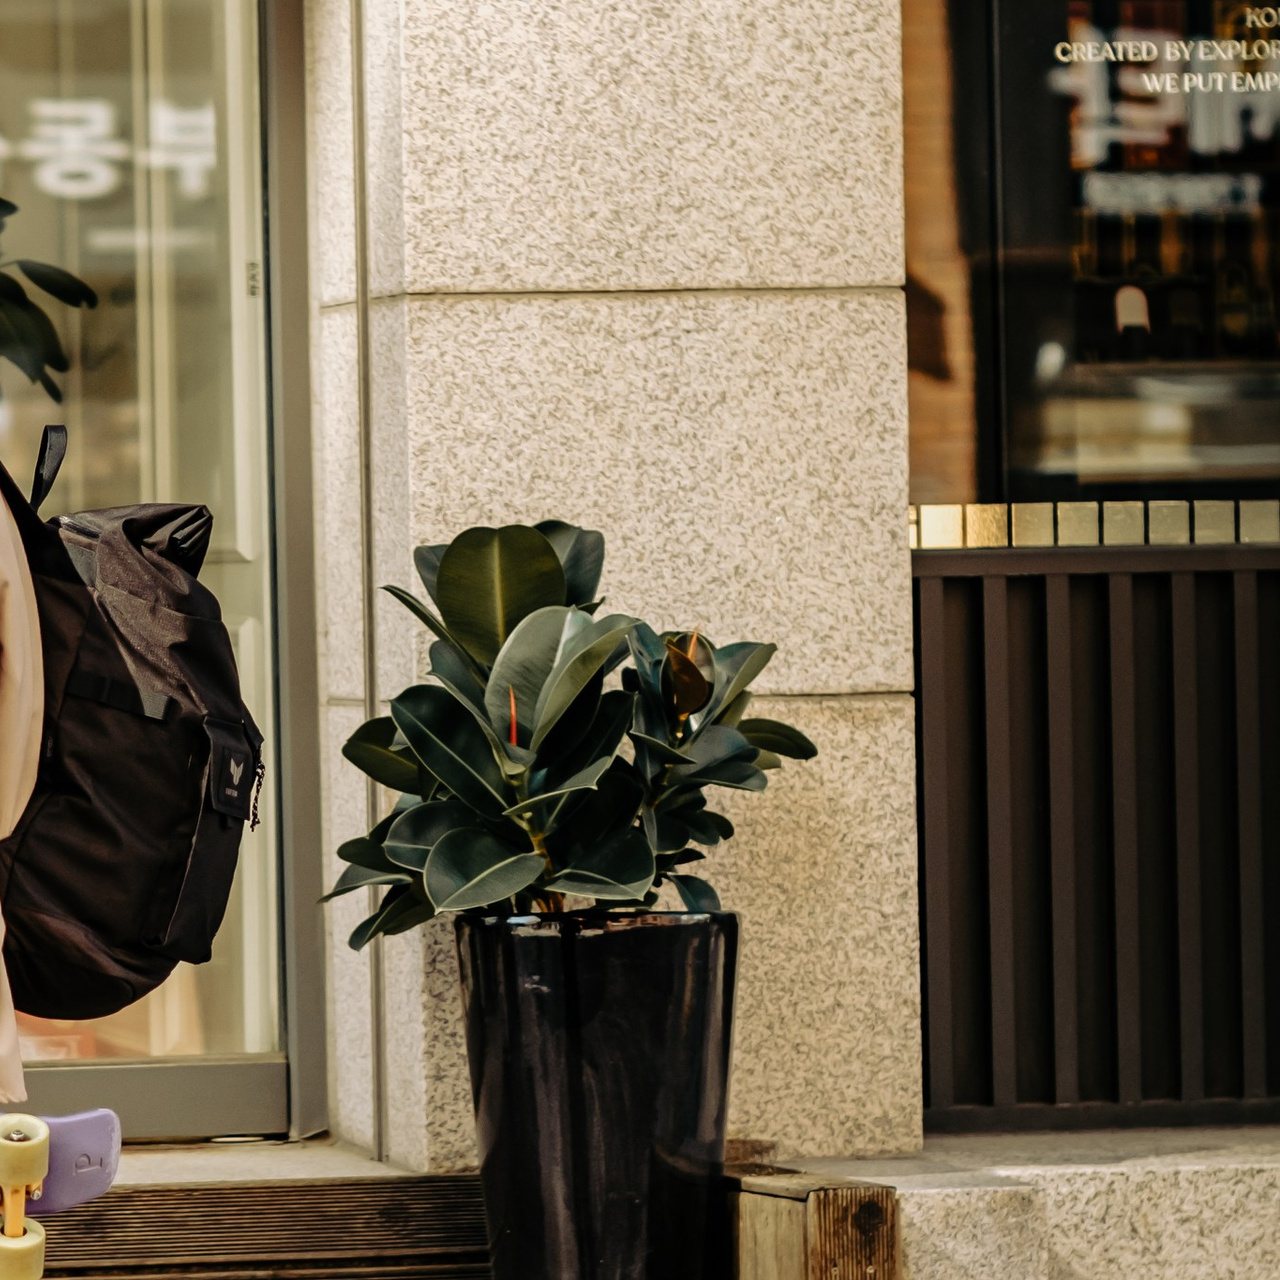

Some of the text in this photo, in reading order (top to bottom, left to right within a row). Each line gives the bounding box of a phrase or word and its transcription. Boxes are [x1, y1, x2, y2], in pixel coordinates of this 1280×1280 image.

[1245, 6, 1280, 28] KO
[1054, 40, 1158, 62] CREATED
[1165, 40, 1195, 62] BY
[1141, 71, 1280, 94] WE PUT EMP
